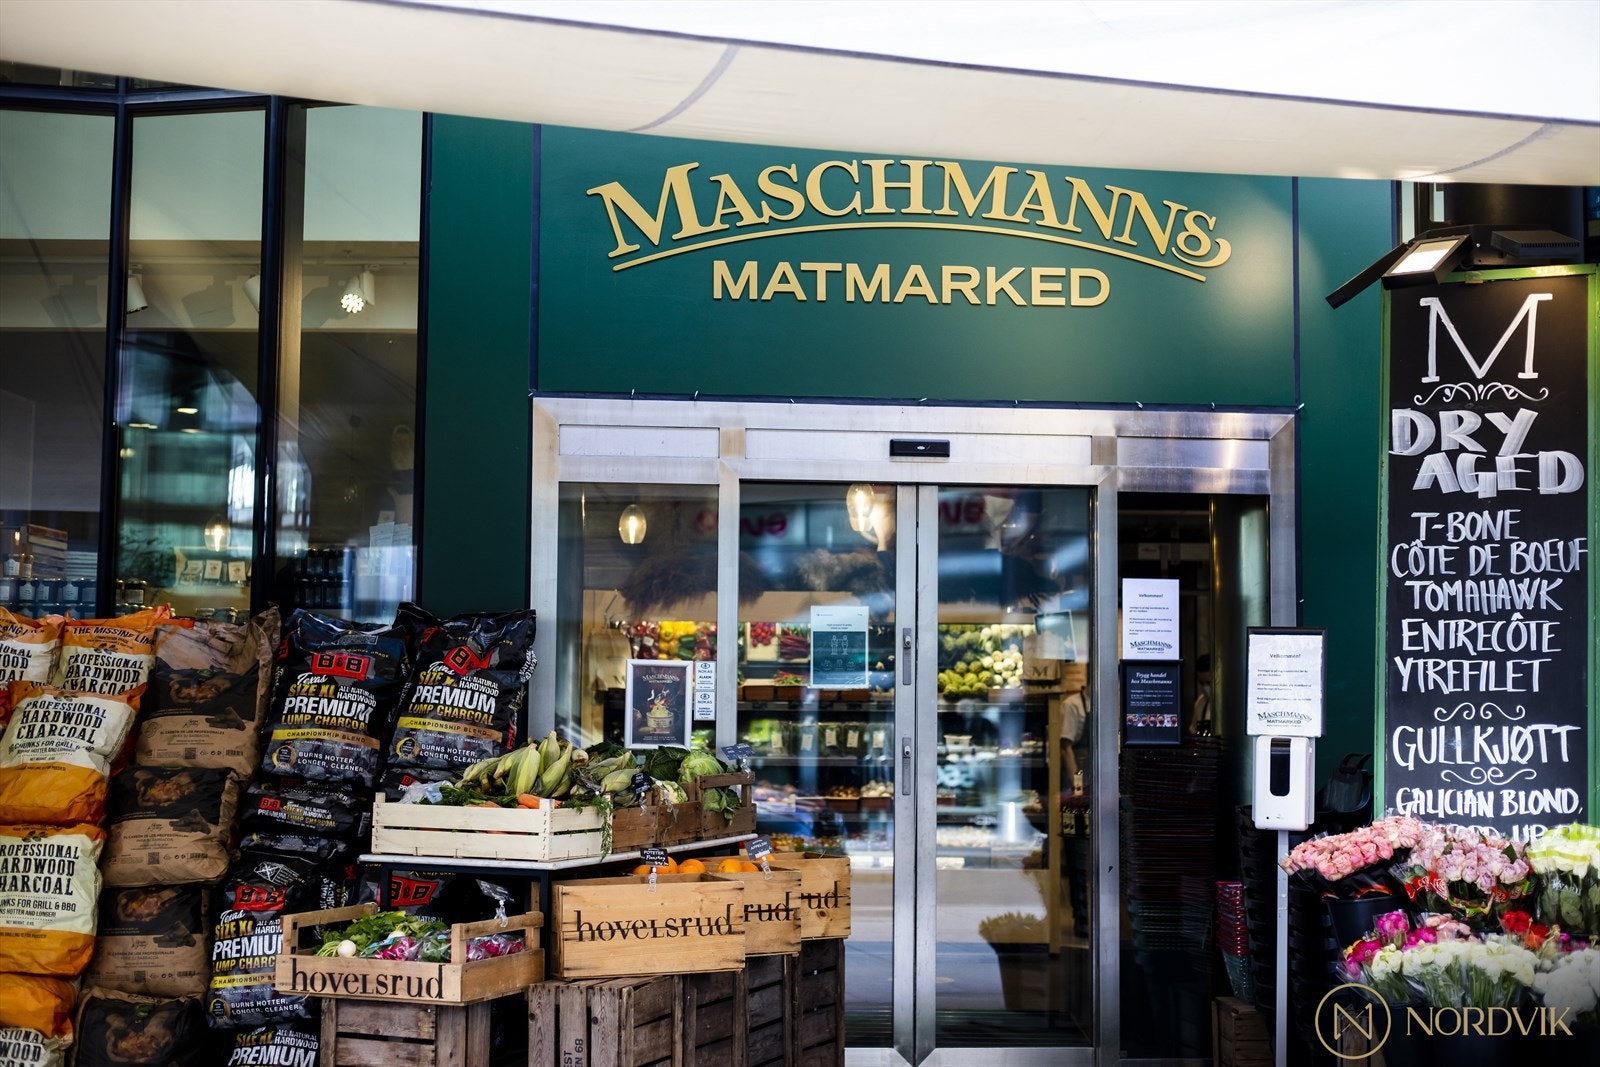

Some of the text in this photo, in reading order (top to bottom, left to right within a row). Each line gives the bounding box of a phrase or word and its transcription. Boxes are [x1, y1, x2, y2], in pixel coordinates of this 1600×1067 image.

[587, 160, 1232, 268] MASCHMANNS
[713, 260, 1110, 306] MATMARKED
[1420, 293, 1553, 383] M
[1389, 408, 1538, 456] DRY
[1412, 450, 1584, 499] AGED
[1411, 509, 1521, 543] T-BONE
[1391, 538, 1588, 577] CÔTE DE BOEUF
[1404, 577, 1563, 615] TOMAHAWK
[1401, 612, 1562, 655] ENTRECÔTE
[68, 653, 144, 670] PROFESSIONAL
[65, 665, 140, 683] HARDWOOD
[1394, 656, 1552, 694] YTREFILET
[289, 684, 317, 697] SIZE
[458, 681, 500, 697] HARDWOOD
[337, 691, 377, 708] HARDWOOD
[411, 686, 496, 714] PREMIUM
[25, 700, 107, 718] PROFESSIONAL
[282, 696, 374, 724] PREMIUM
[408, 703, 494, 726] LUMP CHARCOAL
[20, 710, 104, 729] HARDWOOD
[281, 714, 367, 731] LUMP CHARCOA
[409, 719, 462, 731] CHAMPIONSHIP
[16, 723, 95, 744] CHARCOAL
[286, 731, 366, 743] CHAMPIONSHIP BLEND
[299, 751, 323, 760] BURNS
[421, 744, 445, 753] BURNS
[1392, 723, 1582, 770] GULLKJØTT
[1396, 787, 1494, 818] GALICIAN
[0, 844, 79, 860] ROFESSIONAL
[0, 858, 75, 876] ARDWOOD
[0, 875, 73, 895] HARCOAL
[16, 899, 31, 908] FOR
[32, 899, 53, 910] GRILL
[61, 902, 77, 912] BBQ
[215, 920, 236, 939] SIZE
[213, 956, 276, 973] UMP CHARC
[214, 976, 265, 985] CHAMPIONSHIP
[231, 1001, 255, 1009] BURNS
[265, 1005, 299, 1013] CLEANER
[274, 1036, 318, 1050] HARDWOOD
[575, 1038, 583, 1053] 68
[228, 1045, 316, 1067] PREMIUM
